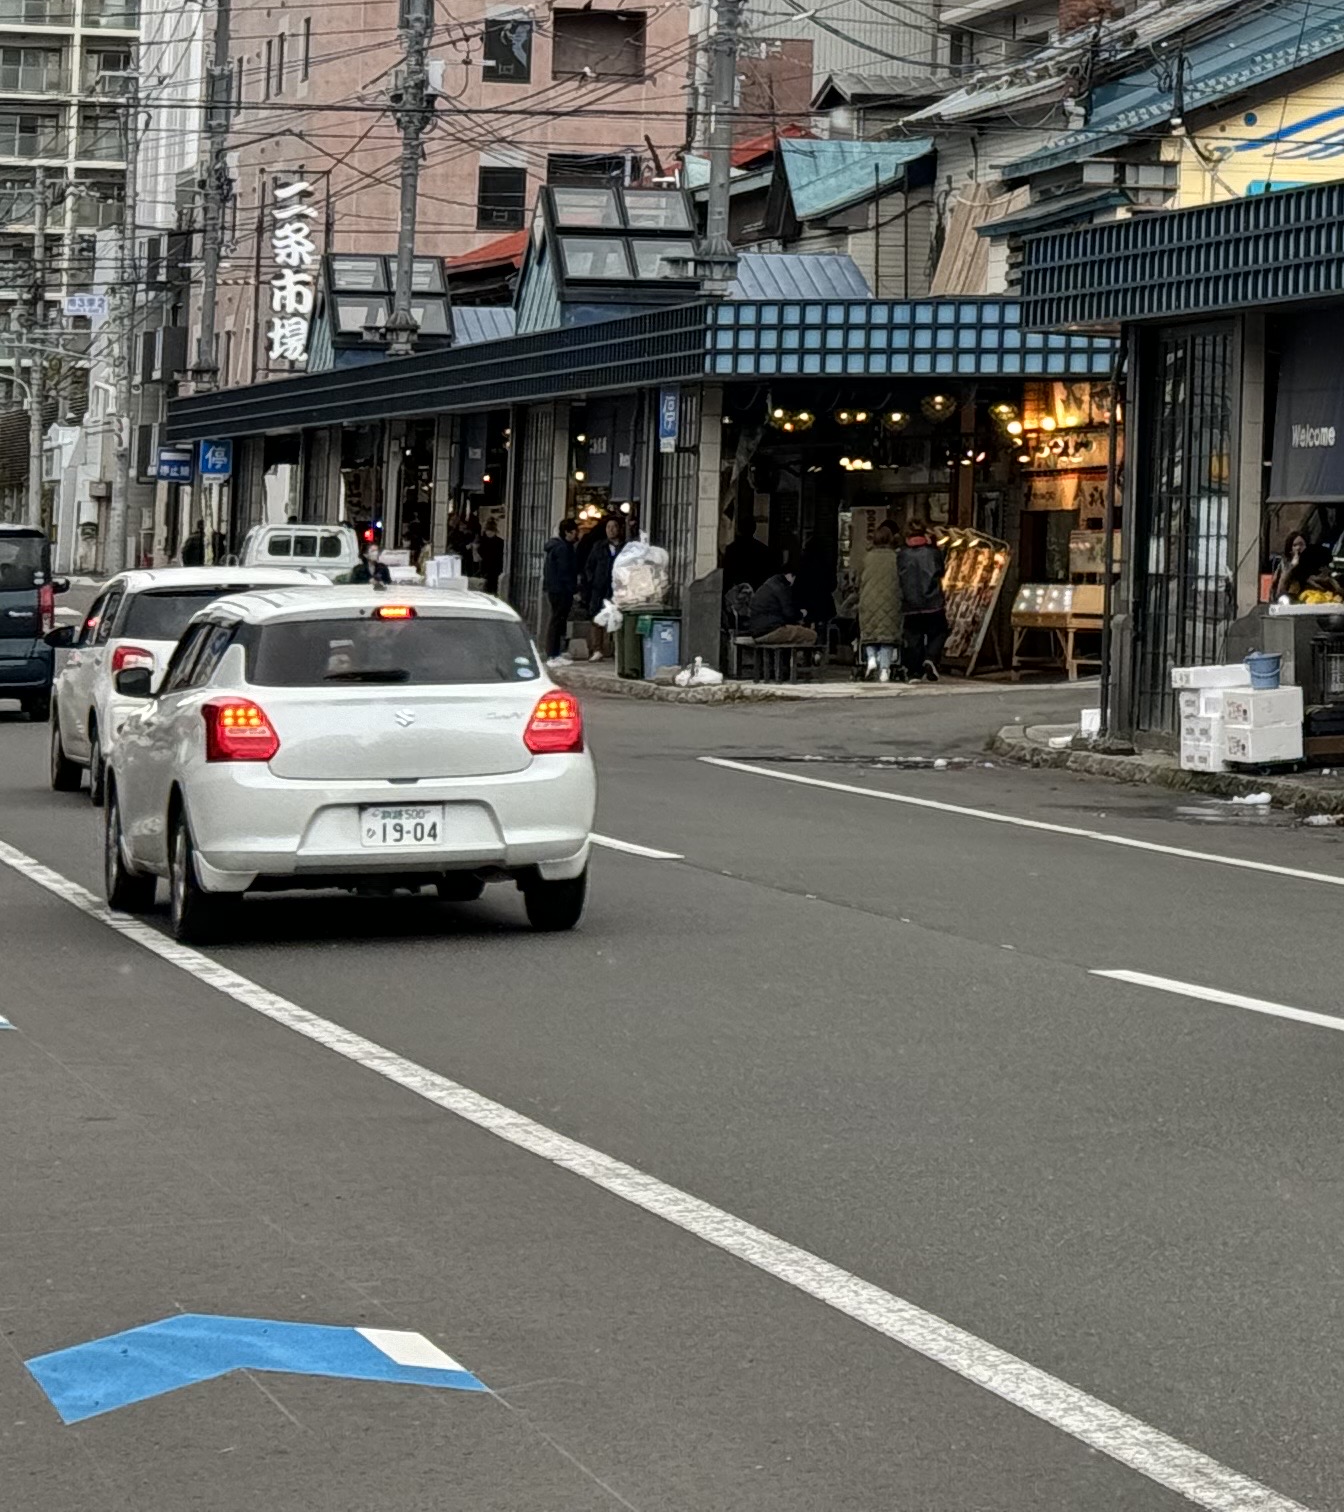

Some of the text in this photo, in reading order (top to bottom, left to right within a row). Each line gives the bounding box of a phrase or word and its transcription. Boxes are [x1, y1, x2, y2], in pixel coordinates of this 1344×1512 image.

[267, 180, 319, 362] 二条市場
[1291, 424, 1336, 449] Welcome
[205, 445, 229, 470] 停
[381, 821, 439, 844] 19-04
